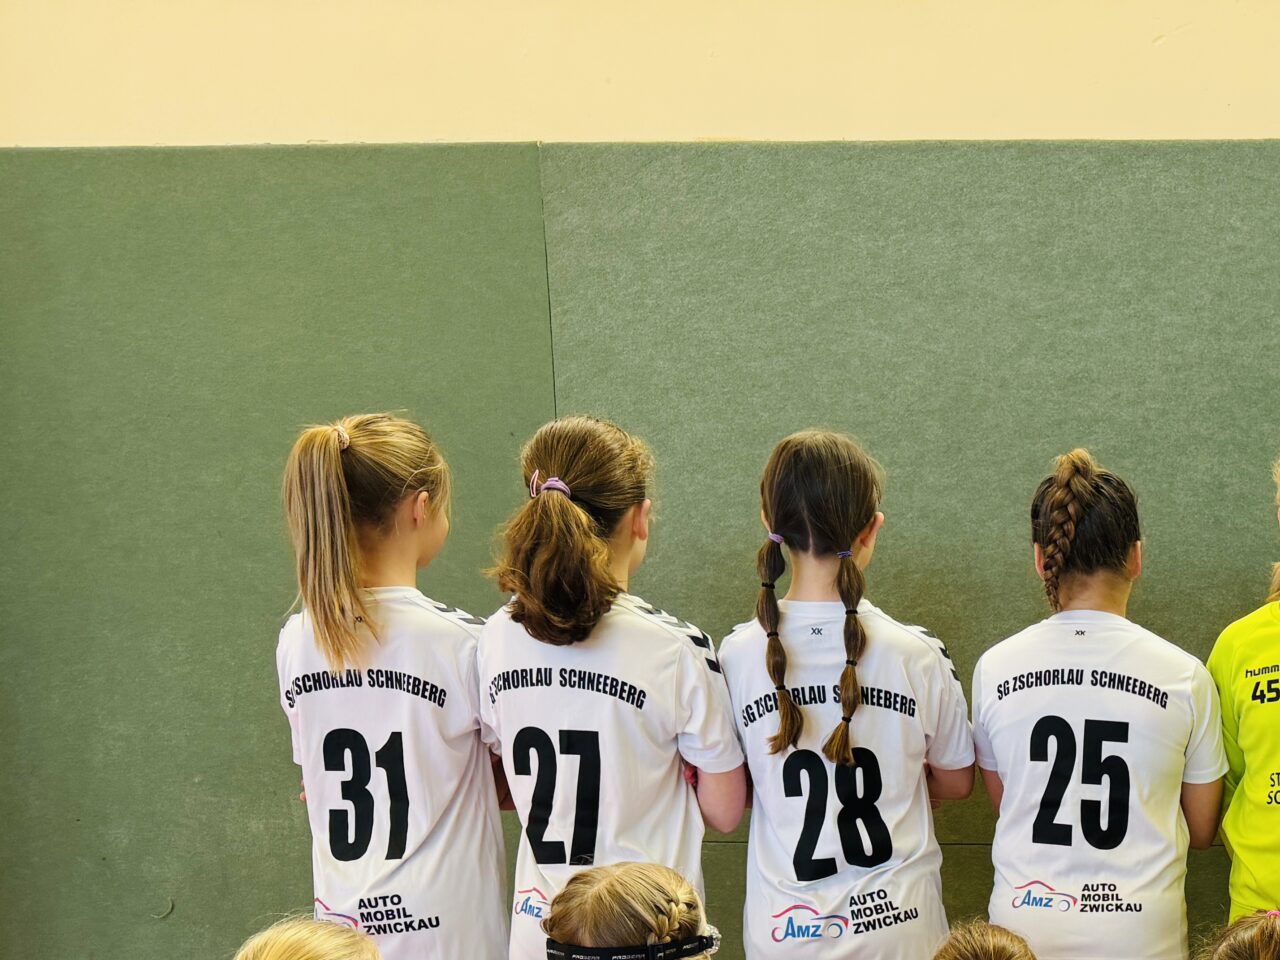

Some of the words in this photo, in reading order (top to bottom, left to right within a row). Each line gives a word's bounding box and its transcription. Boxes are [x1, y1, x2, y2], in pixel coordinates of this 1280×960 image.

[368, 668, 447, 708] SCHNEEBERG
[559, 668, 646, 709] SCHNEEBERG
[833, 685, 916, 717] SNEEBERG
[997, 680, 1009, 701] SG
[1012, 668, 1084, 693] ZSCHORLAU
[1090, 669, 1168, 709] SCHNEEBERG
[1252, 679, 1280, 704] 45
[322, 728, 409, 862] 31
[512, 726, 599, 865] 27
[1030, 715, 1130, 850] 25
[783, 747, 893, 881] 28
[849, 889, 888, 907] AUTO
[1081, 883, 1117, 892] AUTO
[1081, 893, 1123, 902] MOBIL
[357, 894, 401, 910] AUTO
[359, 907, 412, 923] MOBIL
[850, 900, 899, 920] MOBIL
[1079, 903, 1142, 913] ZWICKAU
[363, 916, 440, 935] ZWICKAU
[853, 907, 919, 934] ZWICKAU
